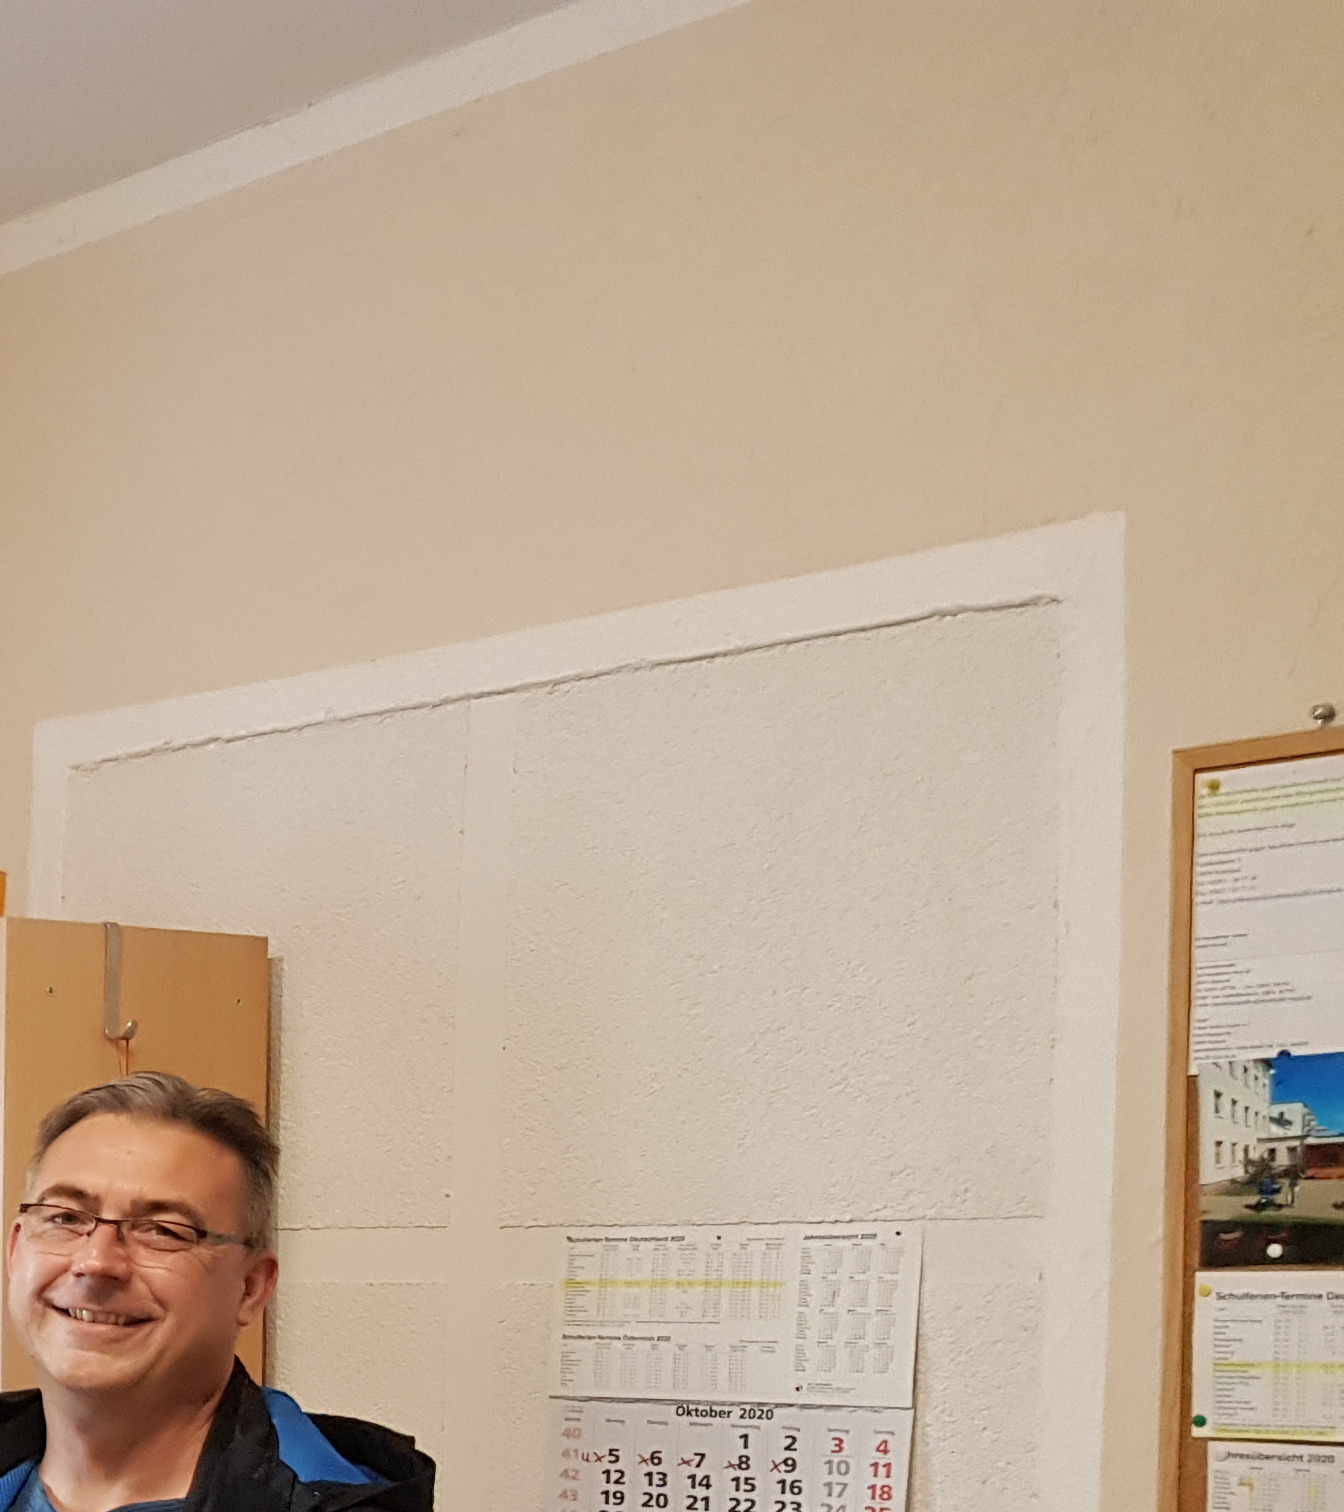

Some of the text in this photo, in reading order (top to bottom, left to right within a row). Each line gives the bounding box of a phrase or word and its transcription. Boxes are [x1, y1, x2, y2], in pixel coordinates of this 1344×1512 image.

[675, 1404, 775, 1422] Oktober 2020
[739, 1433, 890, 1455] 1 2 3 4
[869, 1461, 892, 1479] 11
[602, 1469, 893, 1501] 12 13 14 15 16 18
[600, 1490, 625, 1506] 19
[641, 1492, 668, 1508] 20
[686, 1495, 710, 1512] 21
